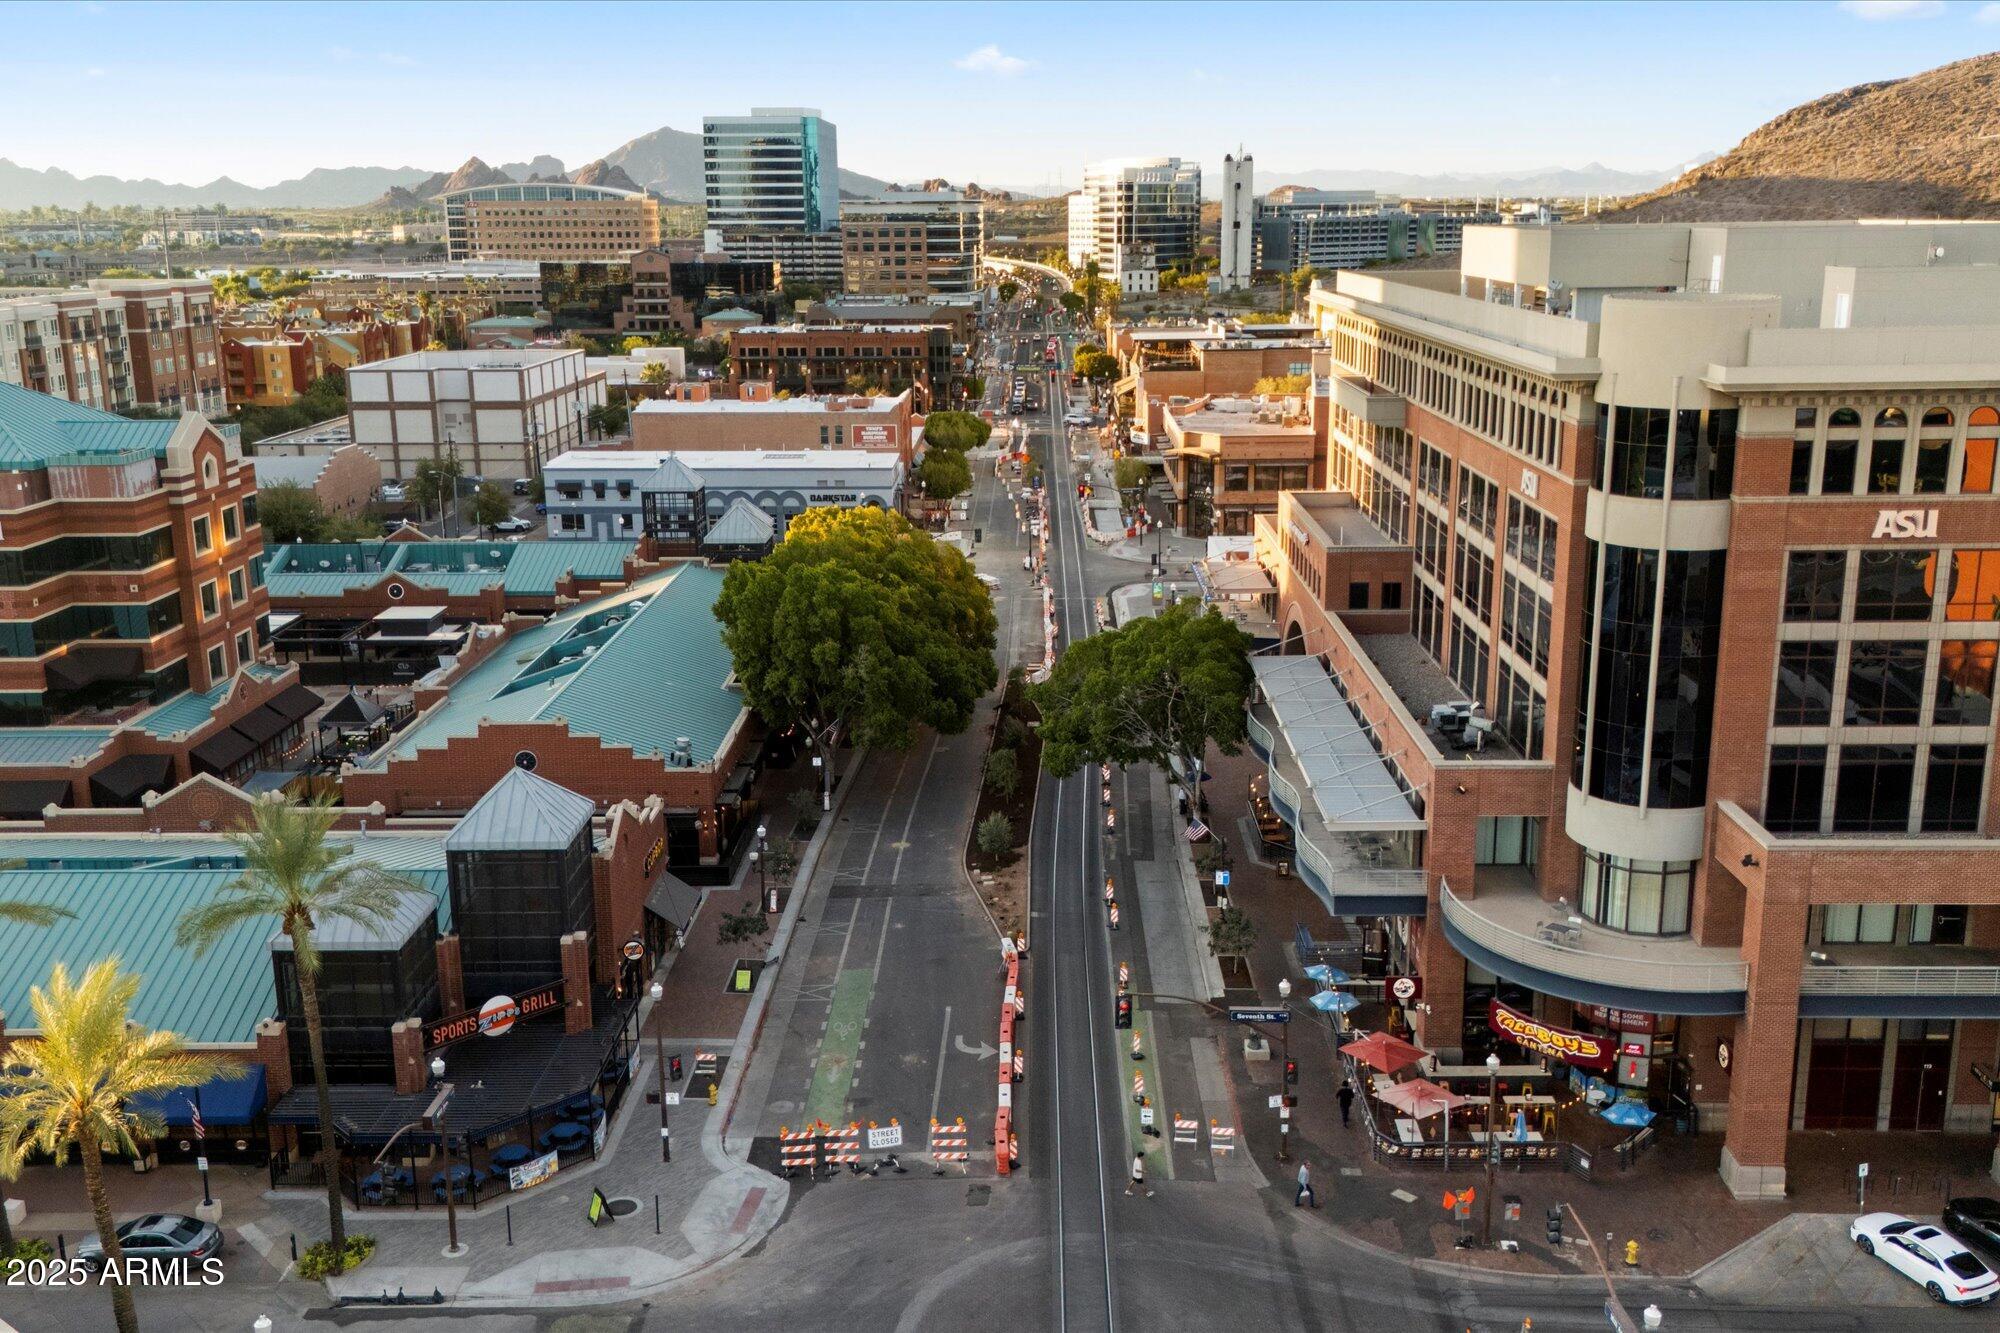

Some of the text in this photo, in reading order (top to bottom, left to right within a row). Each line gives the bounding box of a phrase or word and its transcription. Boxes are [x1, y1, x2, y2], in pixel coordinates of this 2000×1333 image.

[1520, 468, 1538, 499] ASU
[810, 494, 857, 504] DARKSTAR
[1871, 509, 1939, 538] ASU
[433, 1017, 477, 1044] SPORTS
[522, 991, 557, 1014] GRILL
[1622, 1012, 1644, 1020] SOME
[872, 1129, 899, 1138] STREET
[871, 1137, 899, 1146] CLOSED
